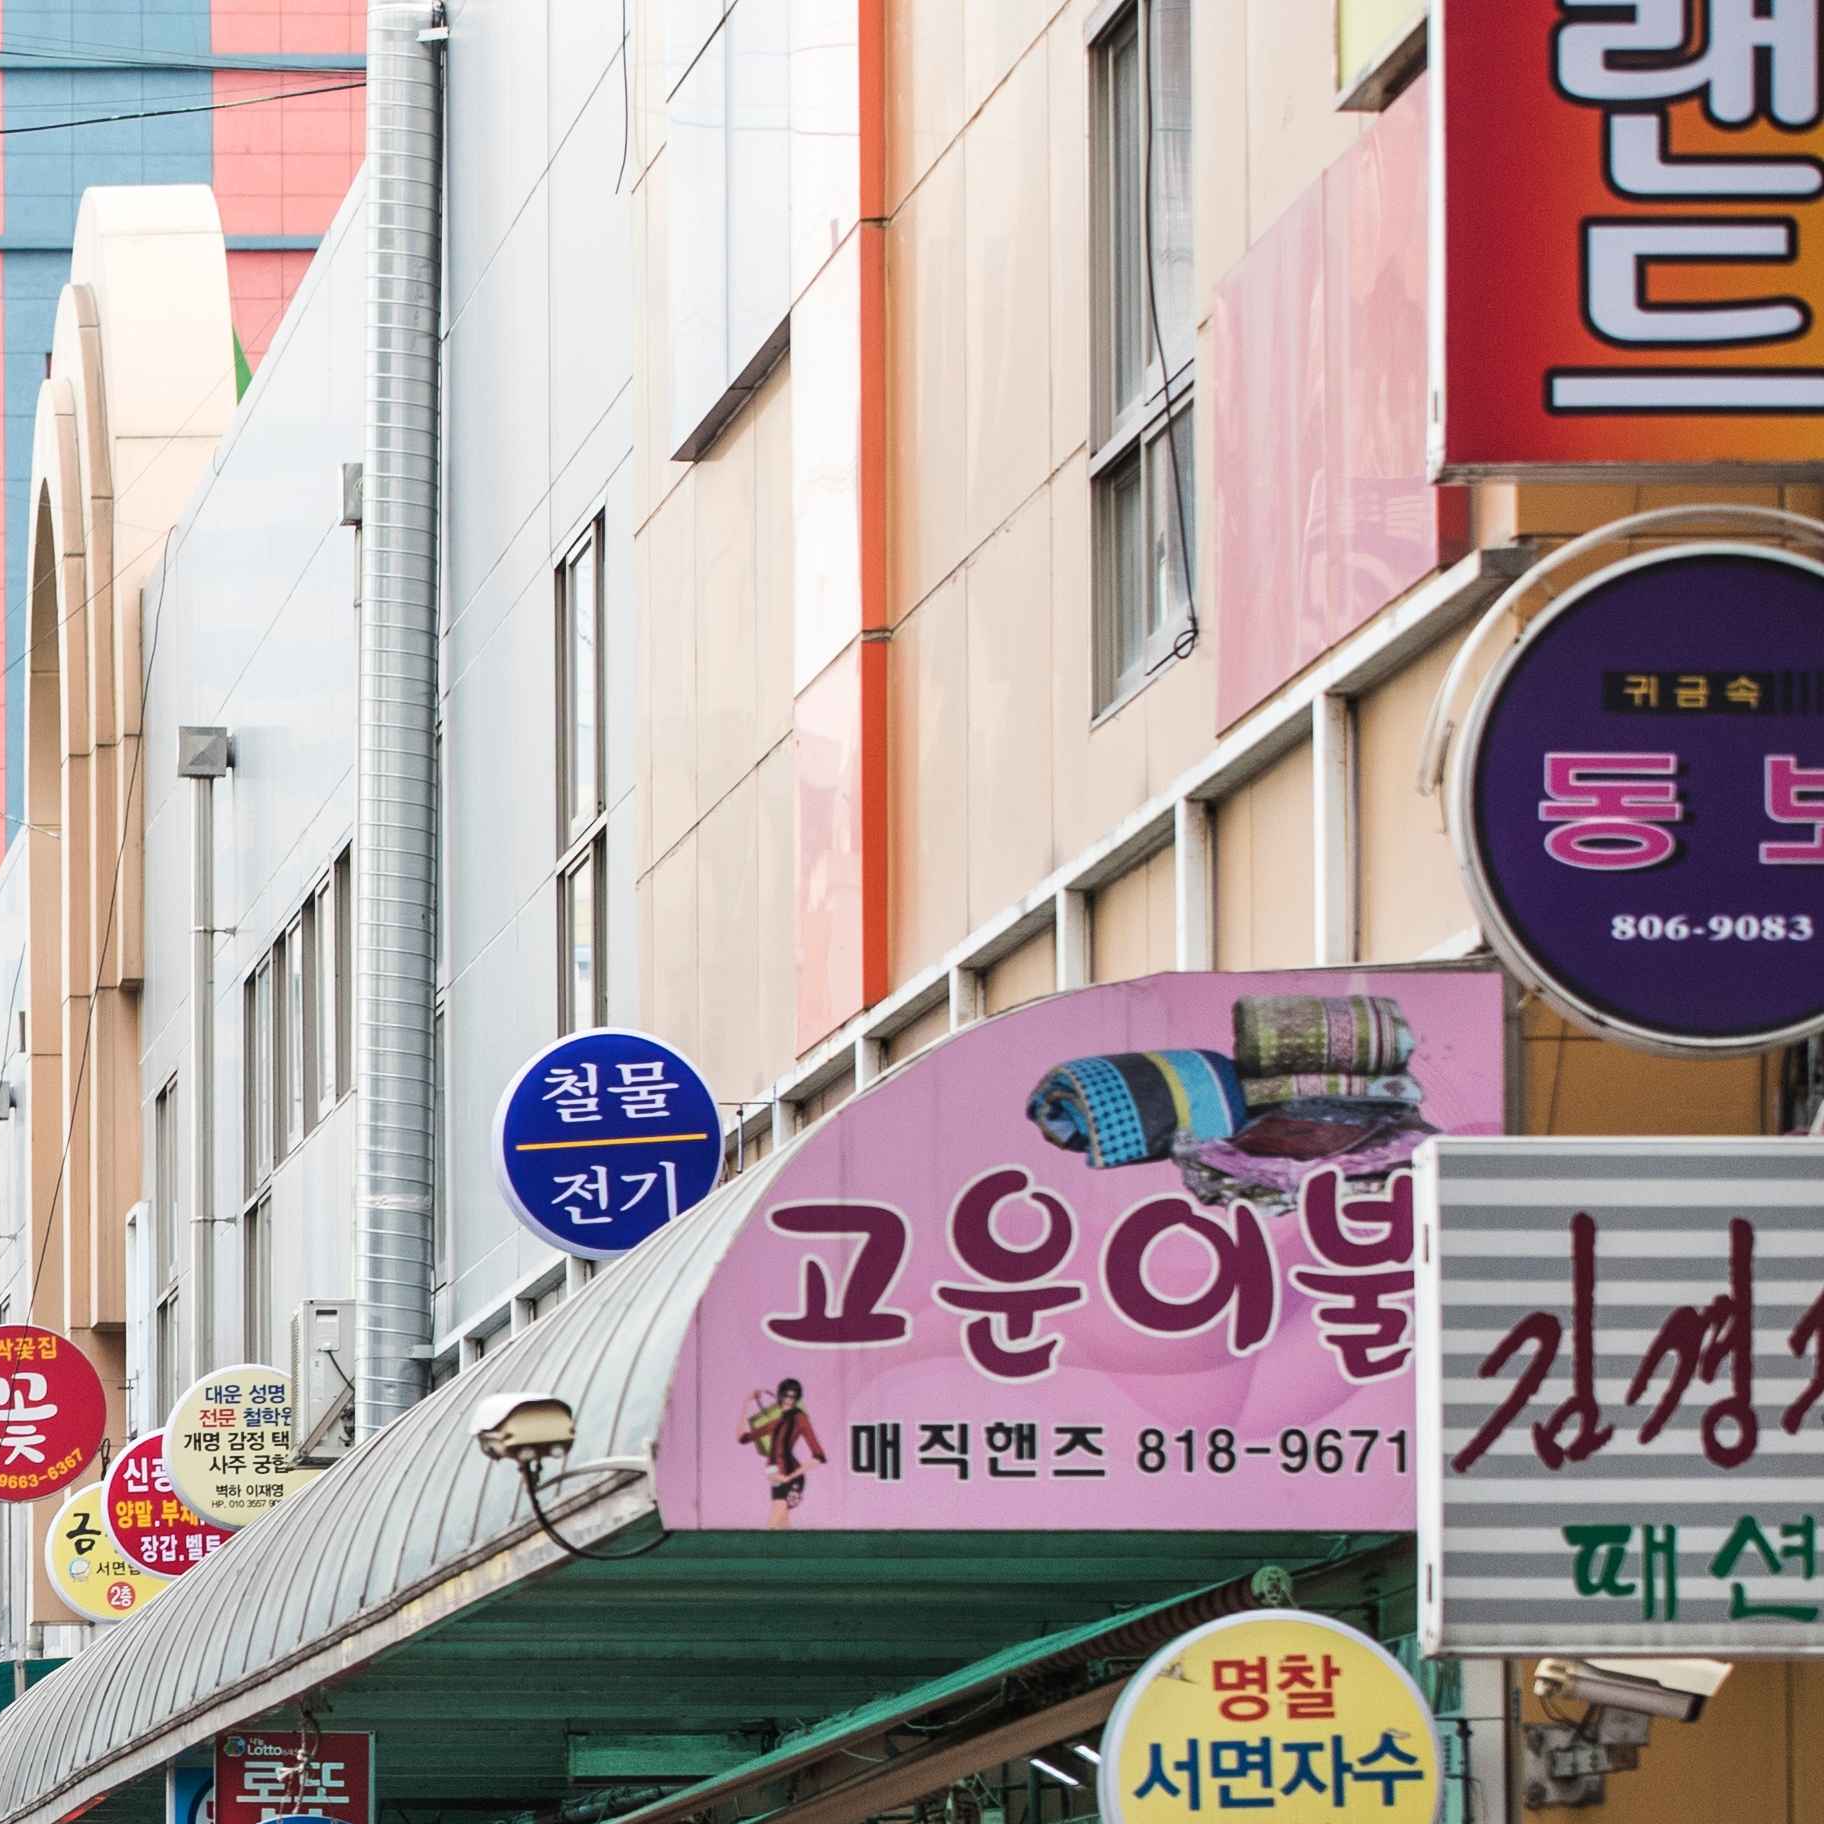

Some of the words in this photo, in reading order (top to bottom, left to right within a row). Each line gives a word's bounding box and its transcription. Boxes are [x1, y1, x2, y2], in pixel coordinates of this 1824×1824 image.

[1624, 674, 1761, 710] 귀금속
[1611, 915, 1814, 941] 806-9083
[542, 1061, 679, 1124] 철물
[552, 1161, 679, 1225] 전기
[205, 1384, 242, 1404] 대운
[249, 1384, 285, 1404] 성명
[200, 1408, 236, 1428] 전문
[184, 1432, 220, 1451] 개명
[228, 1432, 265, 1451] 감정
[850, 1420, 1107, 1482] 매직핸즈
[1135, 1424, 1410, 1476] 818-9671
[209, 1455, 247, 1474] 사주
[246, 1484, 284, 1497] 이재영
[1562, 1515, 1818, 1622] 패션
[111, 1586, 133, 1606] 2층
[1212, 1654, 1342, 1722] 명찰
[247, 1743, 282, 1756] Lotto
[236, 1761, 350, 1804] 로또
[1133, 1733, 1424, 1812] 서면자수
